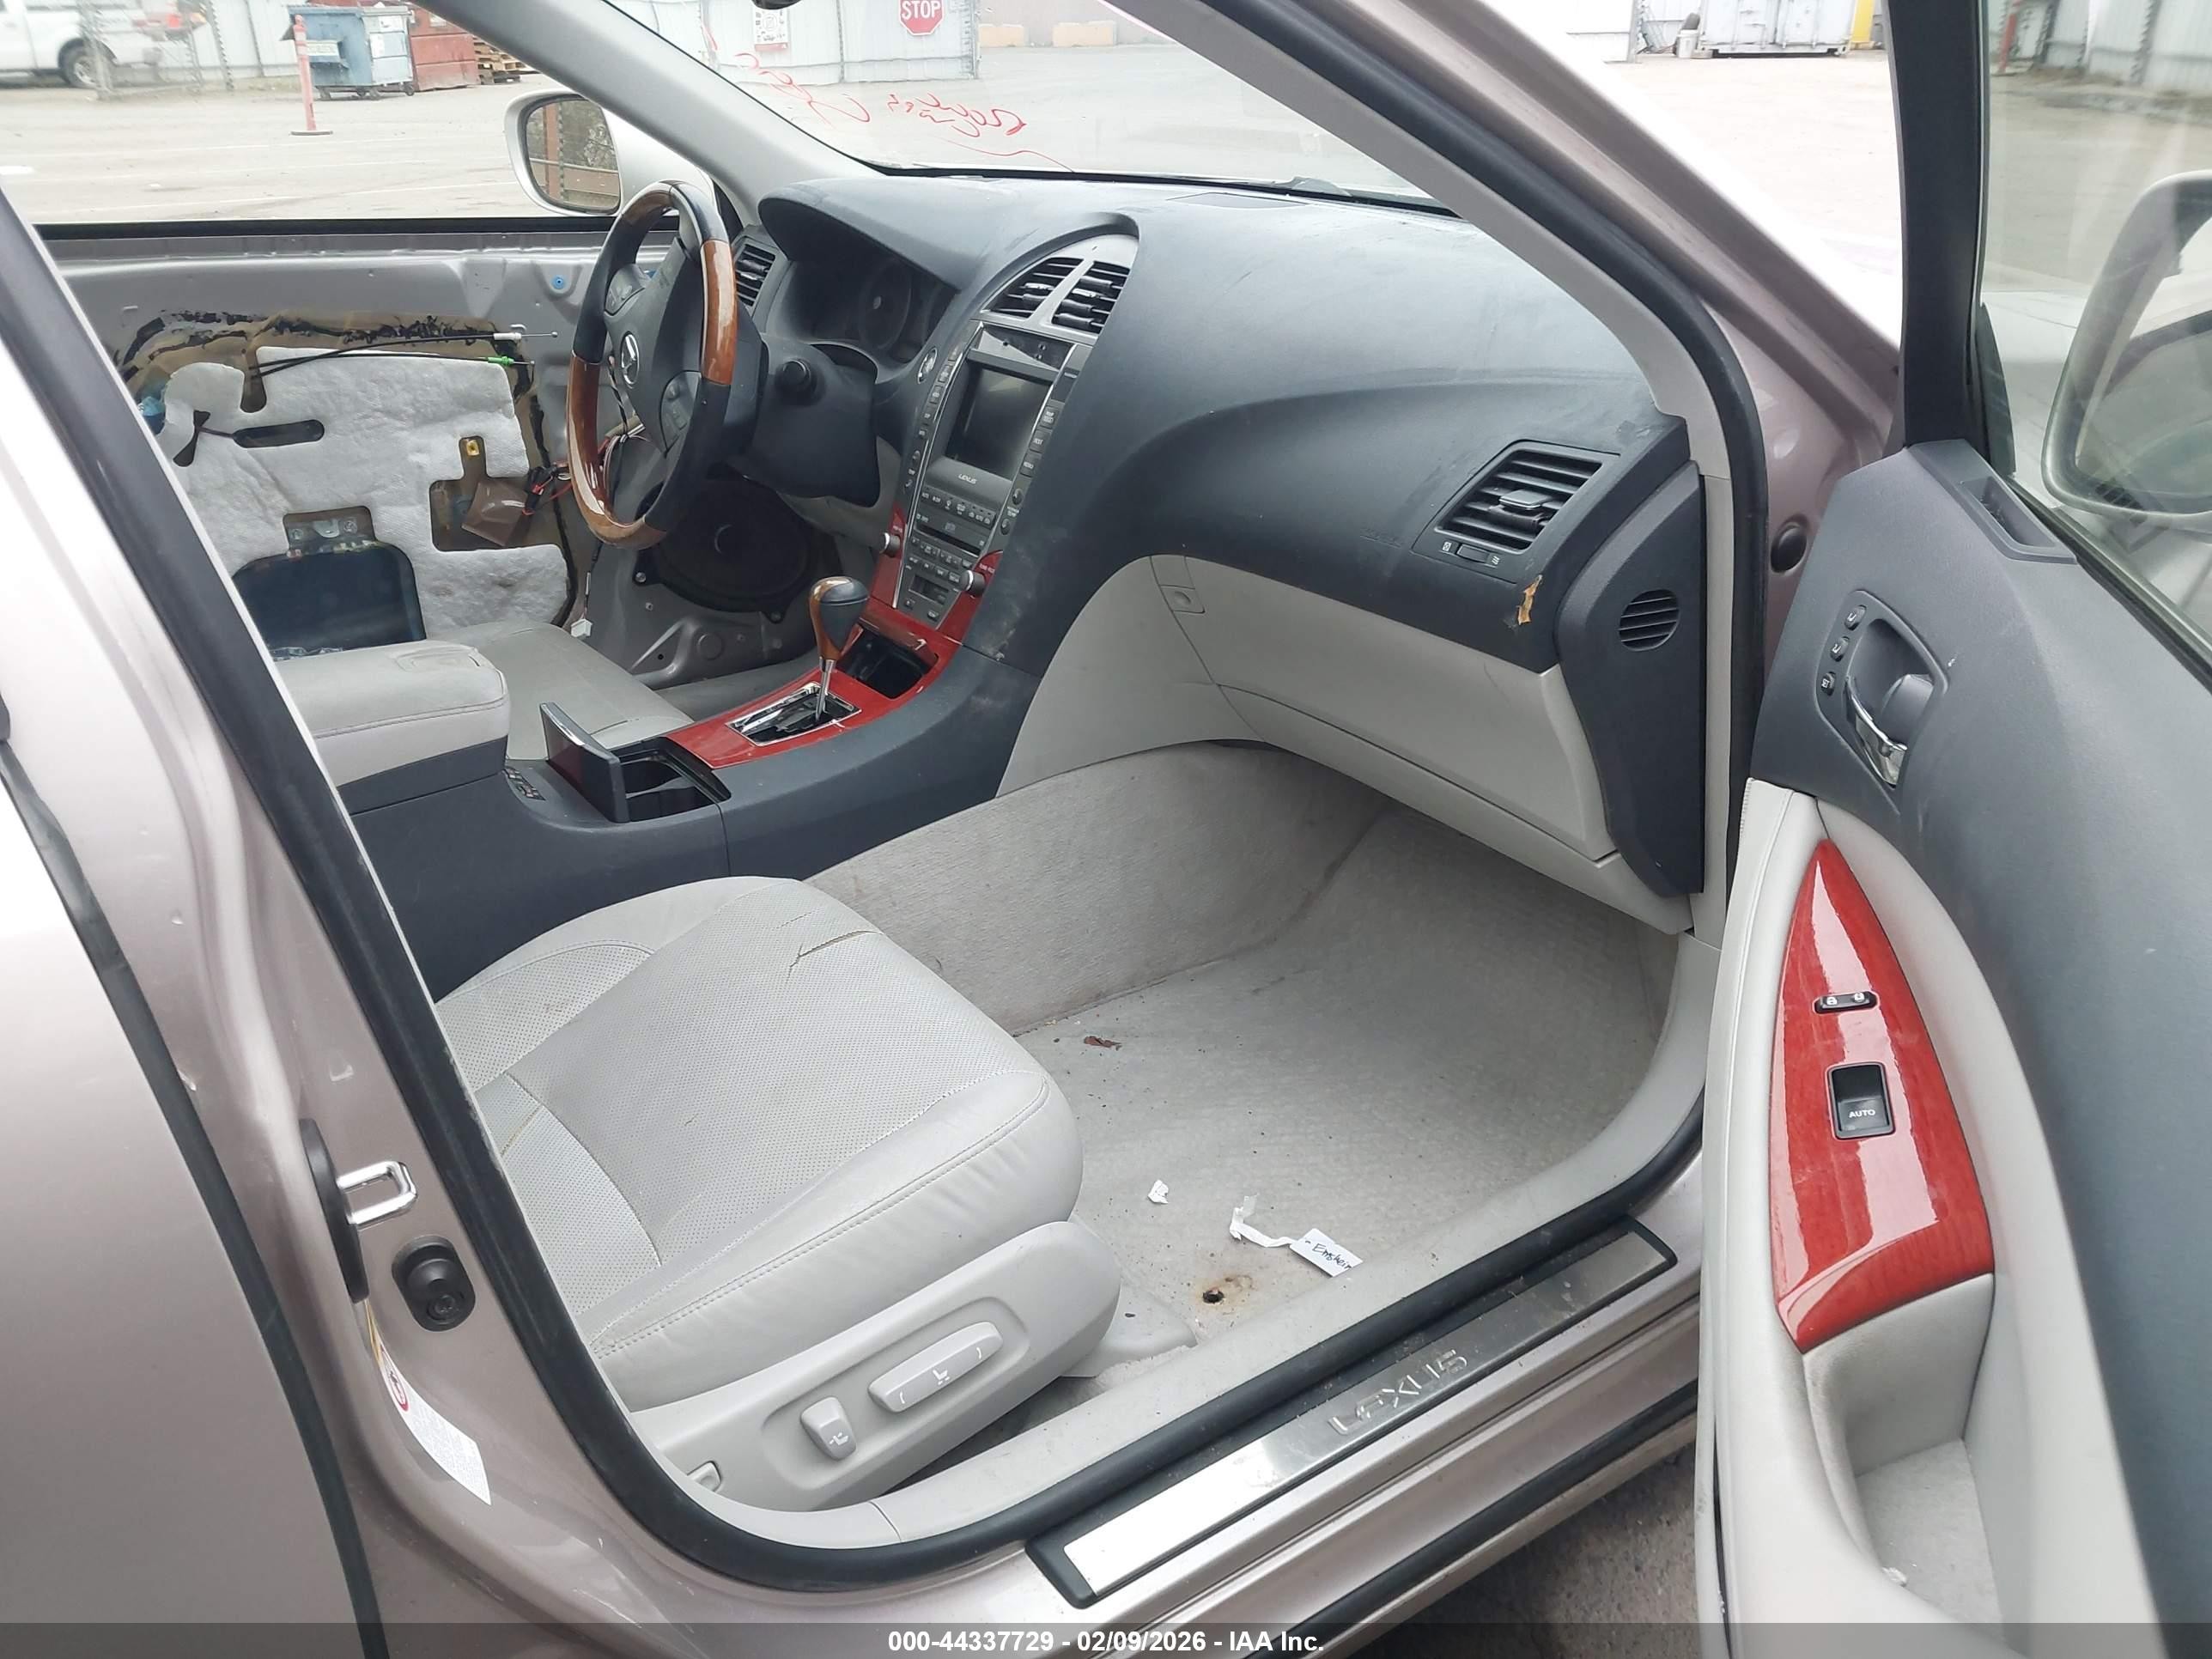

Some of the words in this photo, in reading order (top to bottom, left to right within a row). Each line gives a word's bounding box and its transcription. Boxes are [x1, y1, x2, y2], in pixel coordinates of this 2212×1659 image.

[902, 0, 941, 20] STOP
[1848, 1109, 1876, 1118] AUTO
[1327, 1349, 1468, 1436] LEXUS
